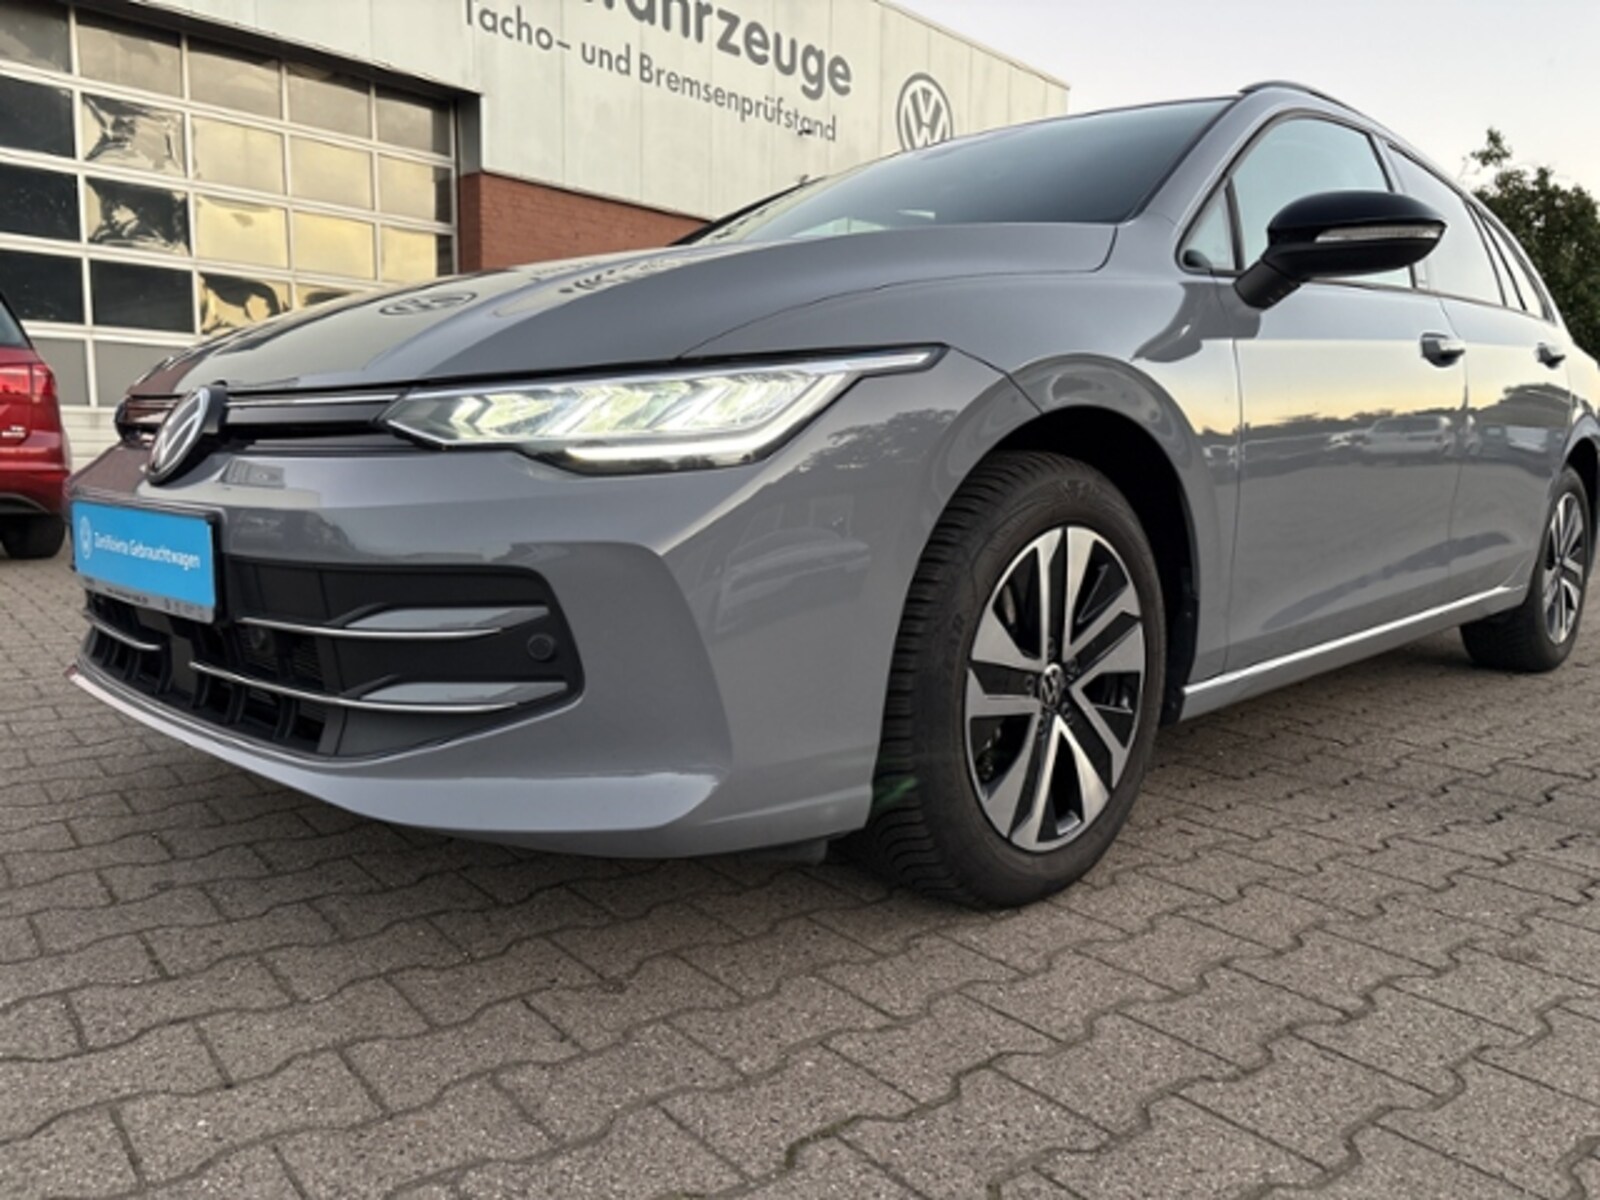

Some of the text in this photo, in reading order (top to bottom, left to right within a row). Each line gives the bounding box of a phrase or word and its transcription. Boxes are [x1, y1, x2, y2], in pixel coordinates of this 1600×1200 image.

[464, 0, 837, 143] Tacho- und Bremsenprüfstand
[603, 0, 852, 101] ahrzeuge
